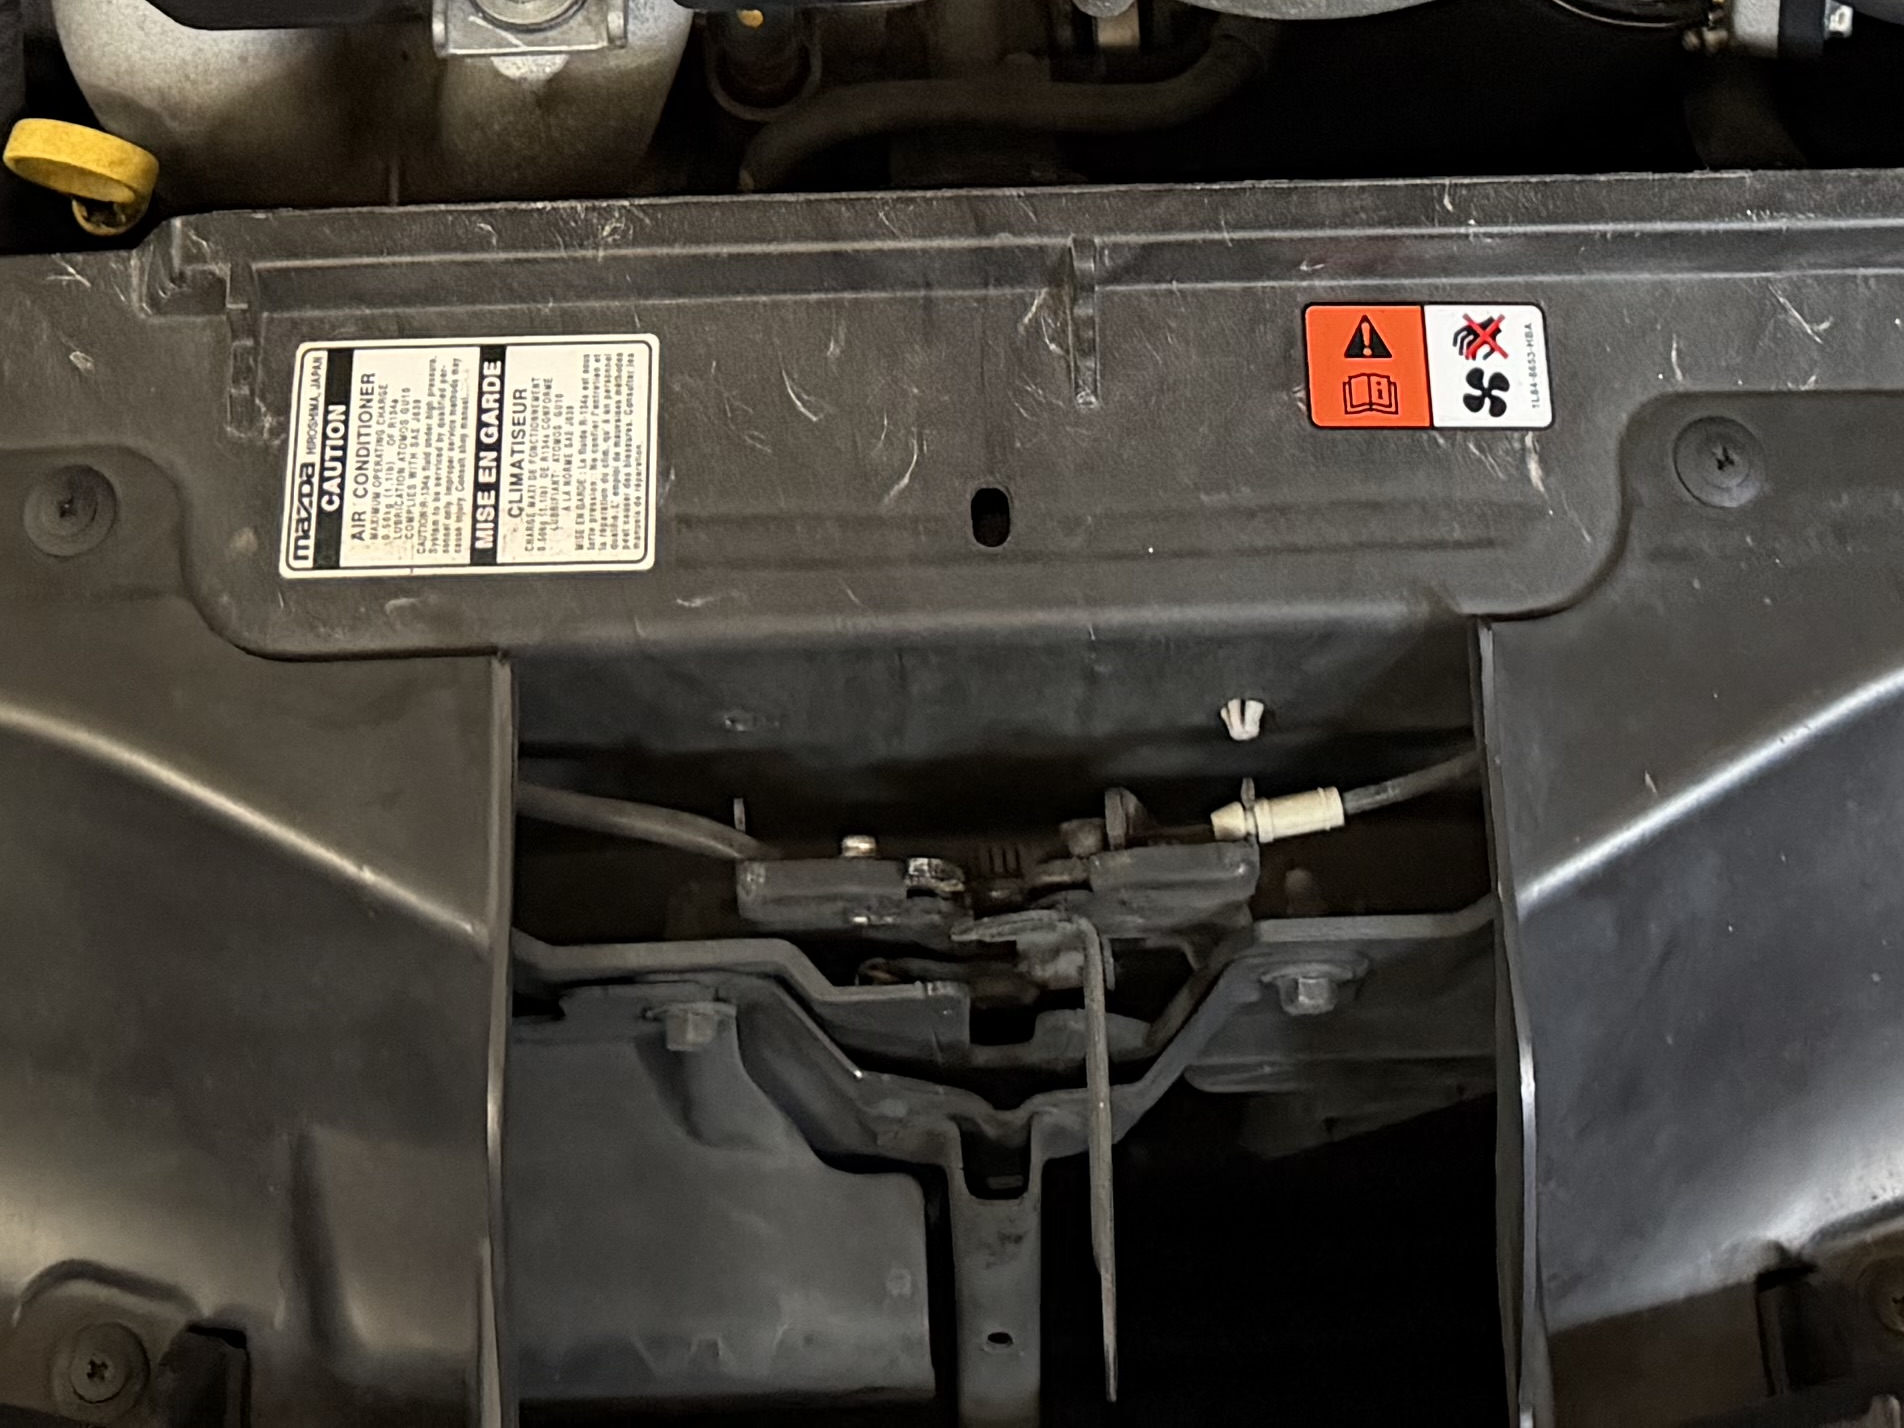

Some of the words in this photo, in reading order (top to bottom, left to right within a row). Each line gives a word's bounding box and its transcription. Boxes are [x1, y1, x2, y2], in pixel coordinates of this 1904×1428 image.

[376, 383, 388, 425] CHARGE
[387, 398, 398, 428] R134a
[424, 400, 436, 419] high
[479, 360, 502, 443] GARDE
[541, 377, 552, 429] CONFORME
[351, 372, 376, 498] CONDITIONER
[423, 423, 433, 447] under
[528, 377, 541, 464] FONCTIONNEMENT
[386, 432, 396, 445] OF
[397, 419, 408, 461] ATOMOS
[410, 427, 419, 447] SAE
[435, 432, 446, 442] by
[506, 387, 529, 518] CLIMATISEUR
[292, 461, 316, 560] mazda
[310, 356, 323, 389] JAPAN
[319, 404, 347, 511] CAUTION
[372, 428, 385, 488] OPERATING
[408, 452, 418, 478] WITH
[421, 451, 431, 470] fluid
[432, 446, 443, 487] serviced
[477, 451, 497, 483] EN
[539, 465, 548, 478] DE
[562, 452, 573, 486] NORME
[527, 468, 537, 480] DE
[392, 466, 406, 540] LUBRICATION
[431, 491, 441, 502] be
[526, 484, 536, 507] MAXI
[561, 490, 571, 501] LA
[576, 478, 586, 509] GARDE
[350, 510, 367, 541] AIR
[368, 491, 381, 540] MAXIMUM
[404, 483, 417, 539] COMPLIES
[431, 506, 440, 515] to
[474, 490, 496, 549] MISE
[575, 512, 585, 525] EN
[428, 519, 441, 554] System
[524, 512, 535, 551] CHARGE
[574, 529, 584, 550] MISE
